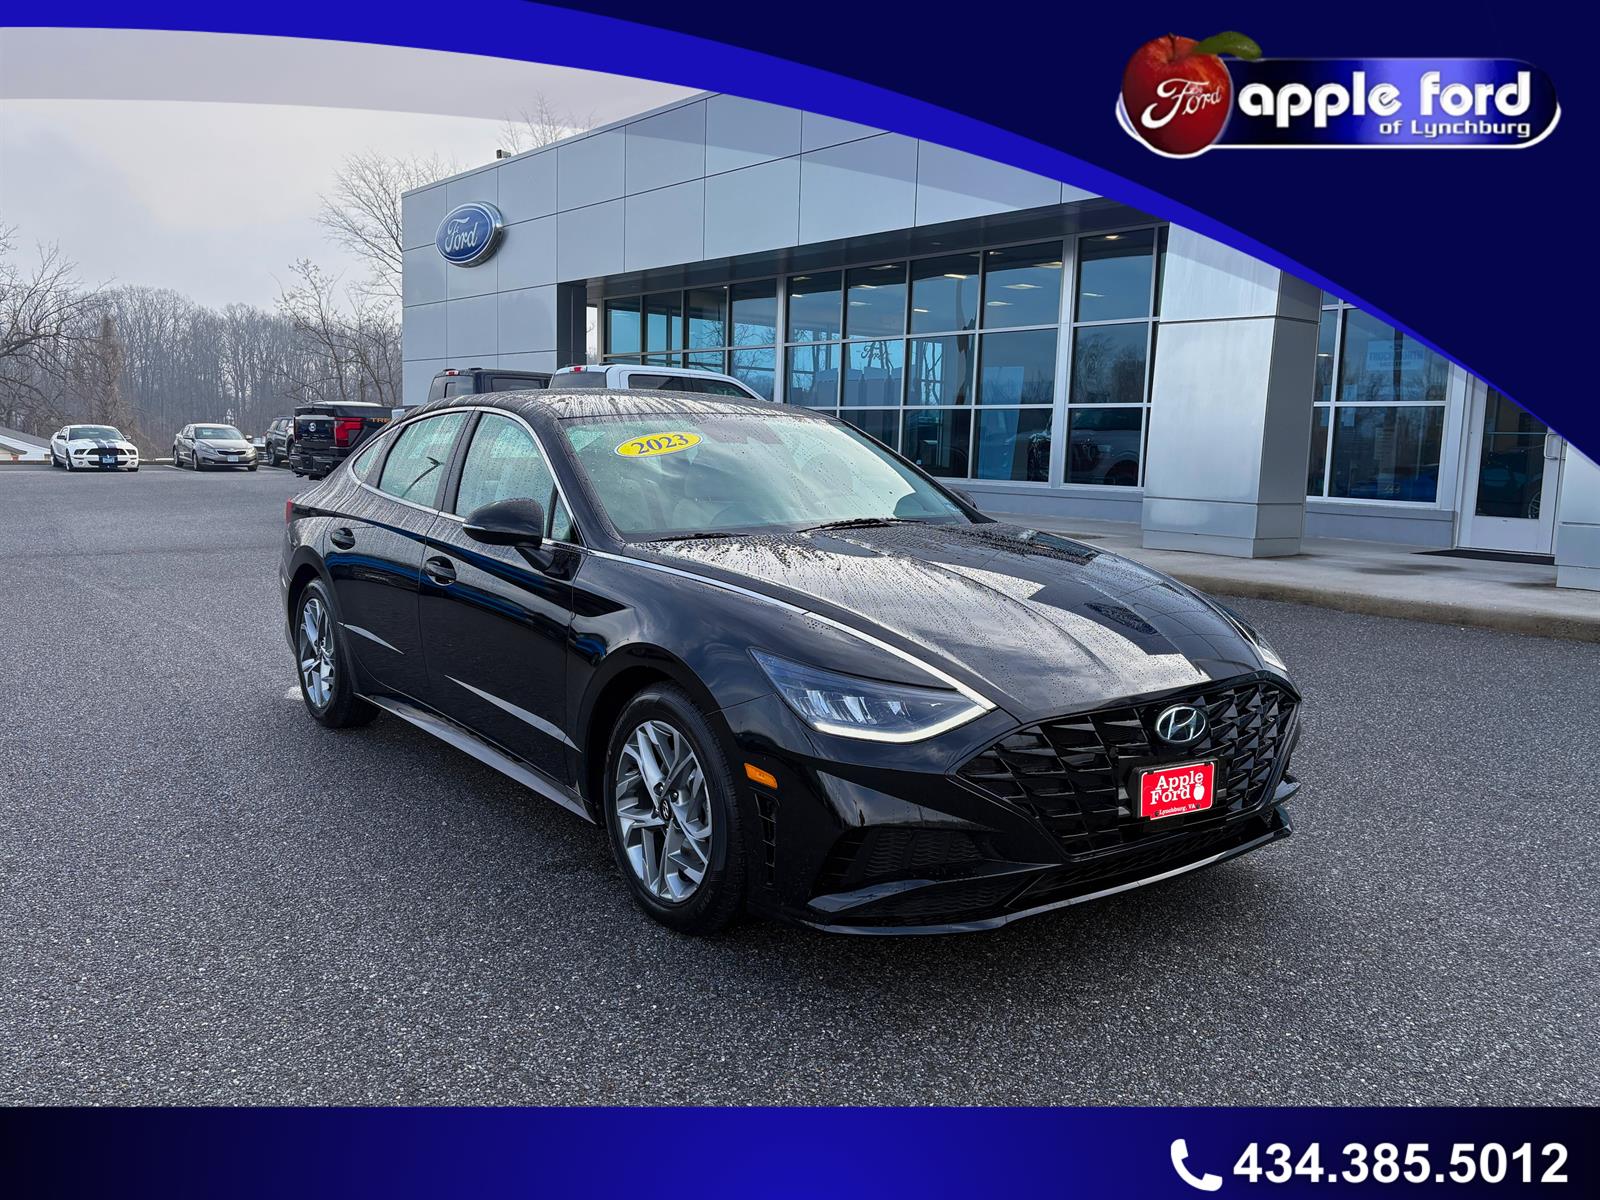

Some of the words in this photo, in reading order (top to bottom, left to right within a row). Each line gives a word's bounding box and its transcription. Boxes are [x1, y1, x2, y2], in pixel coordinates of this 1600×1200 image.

[445, 216, 479, 253] Ford
[631, 434, 689, 454] 2023
[1155, 770, 1204, 792] Apple
[1150, 785, 1190, 805] Ford
